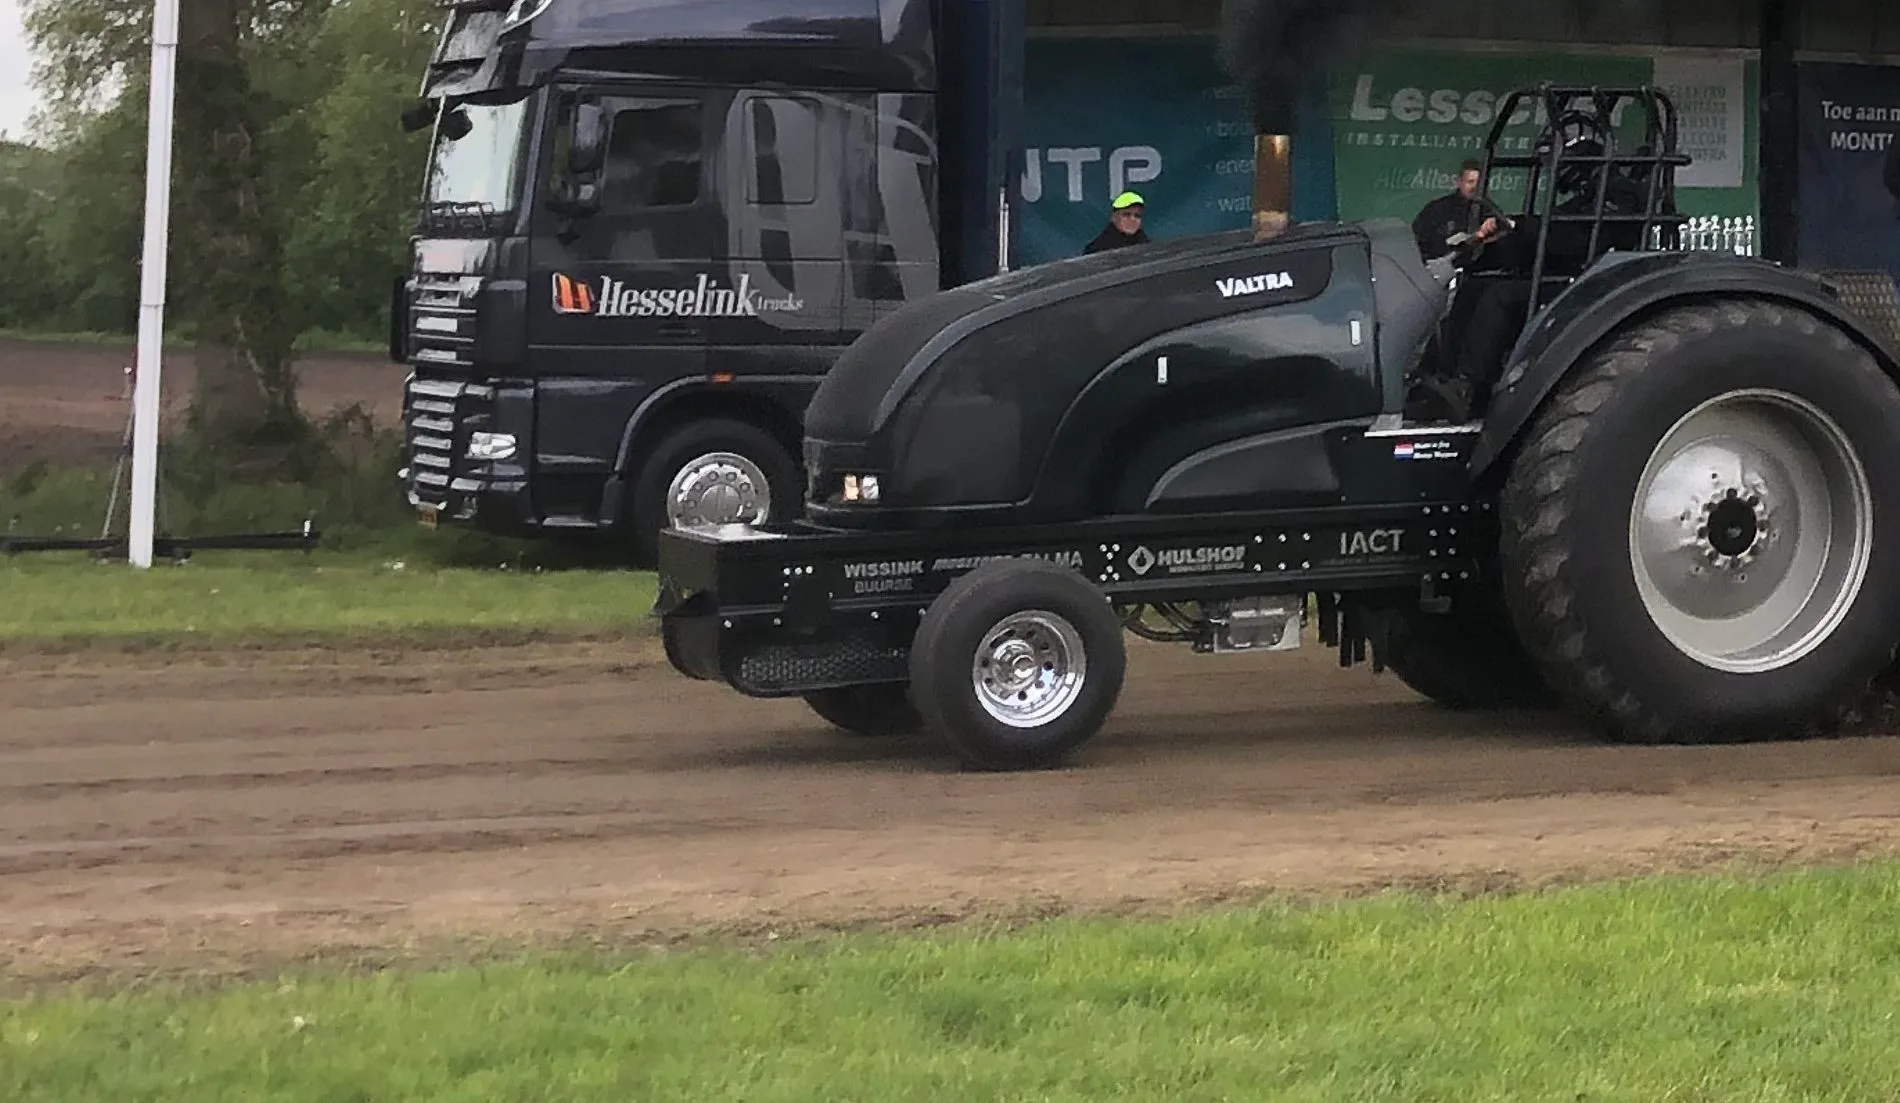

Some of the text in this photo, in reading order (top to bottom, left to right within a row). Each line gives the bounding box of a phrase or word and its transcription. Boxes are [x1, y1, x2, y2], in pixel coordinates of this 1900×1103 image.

[1822, 101, 1852, 120] Toe
[1855, 106, 1890, 121] aan
[596, 273, 760, 317] Hesselink
[1216, 272, 1293, 298] VALTRA
[1340, 529, 1404, 555] IACT
[1157, 545, 1246, 566] HULSHOF
[844, 560, 924, 578] WISSINK
